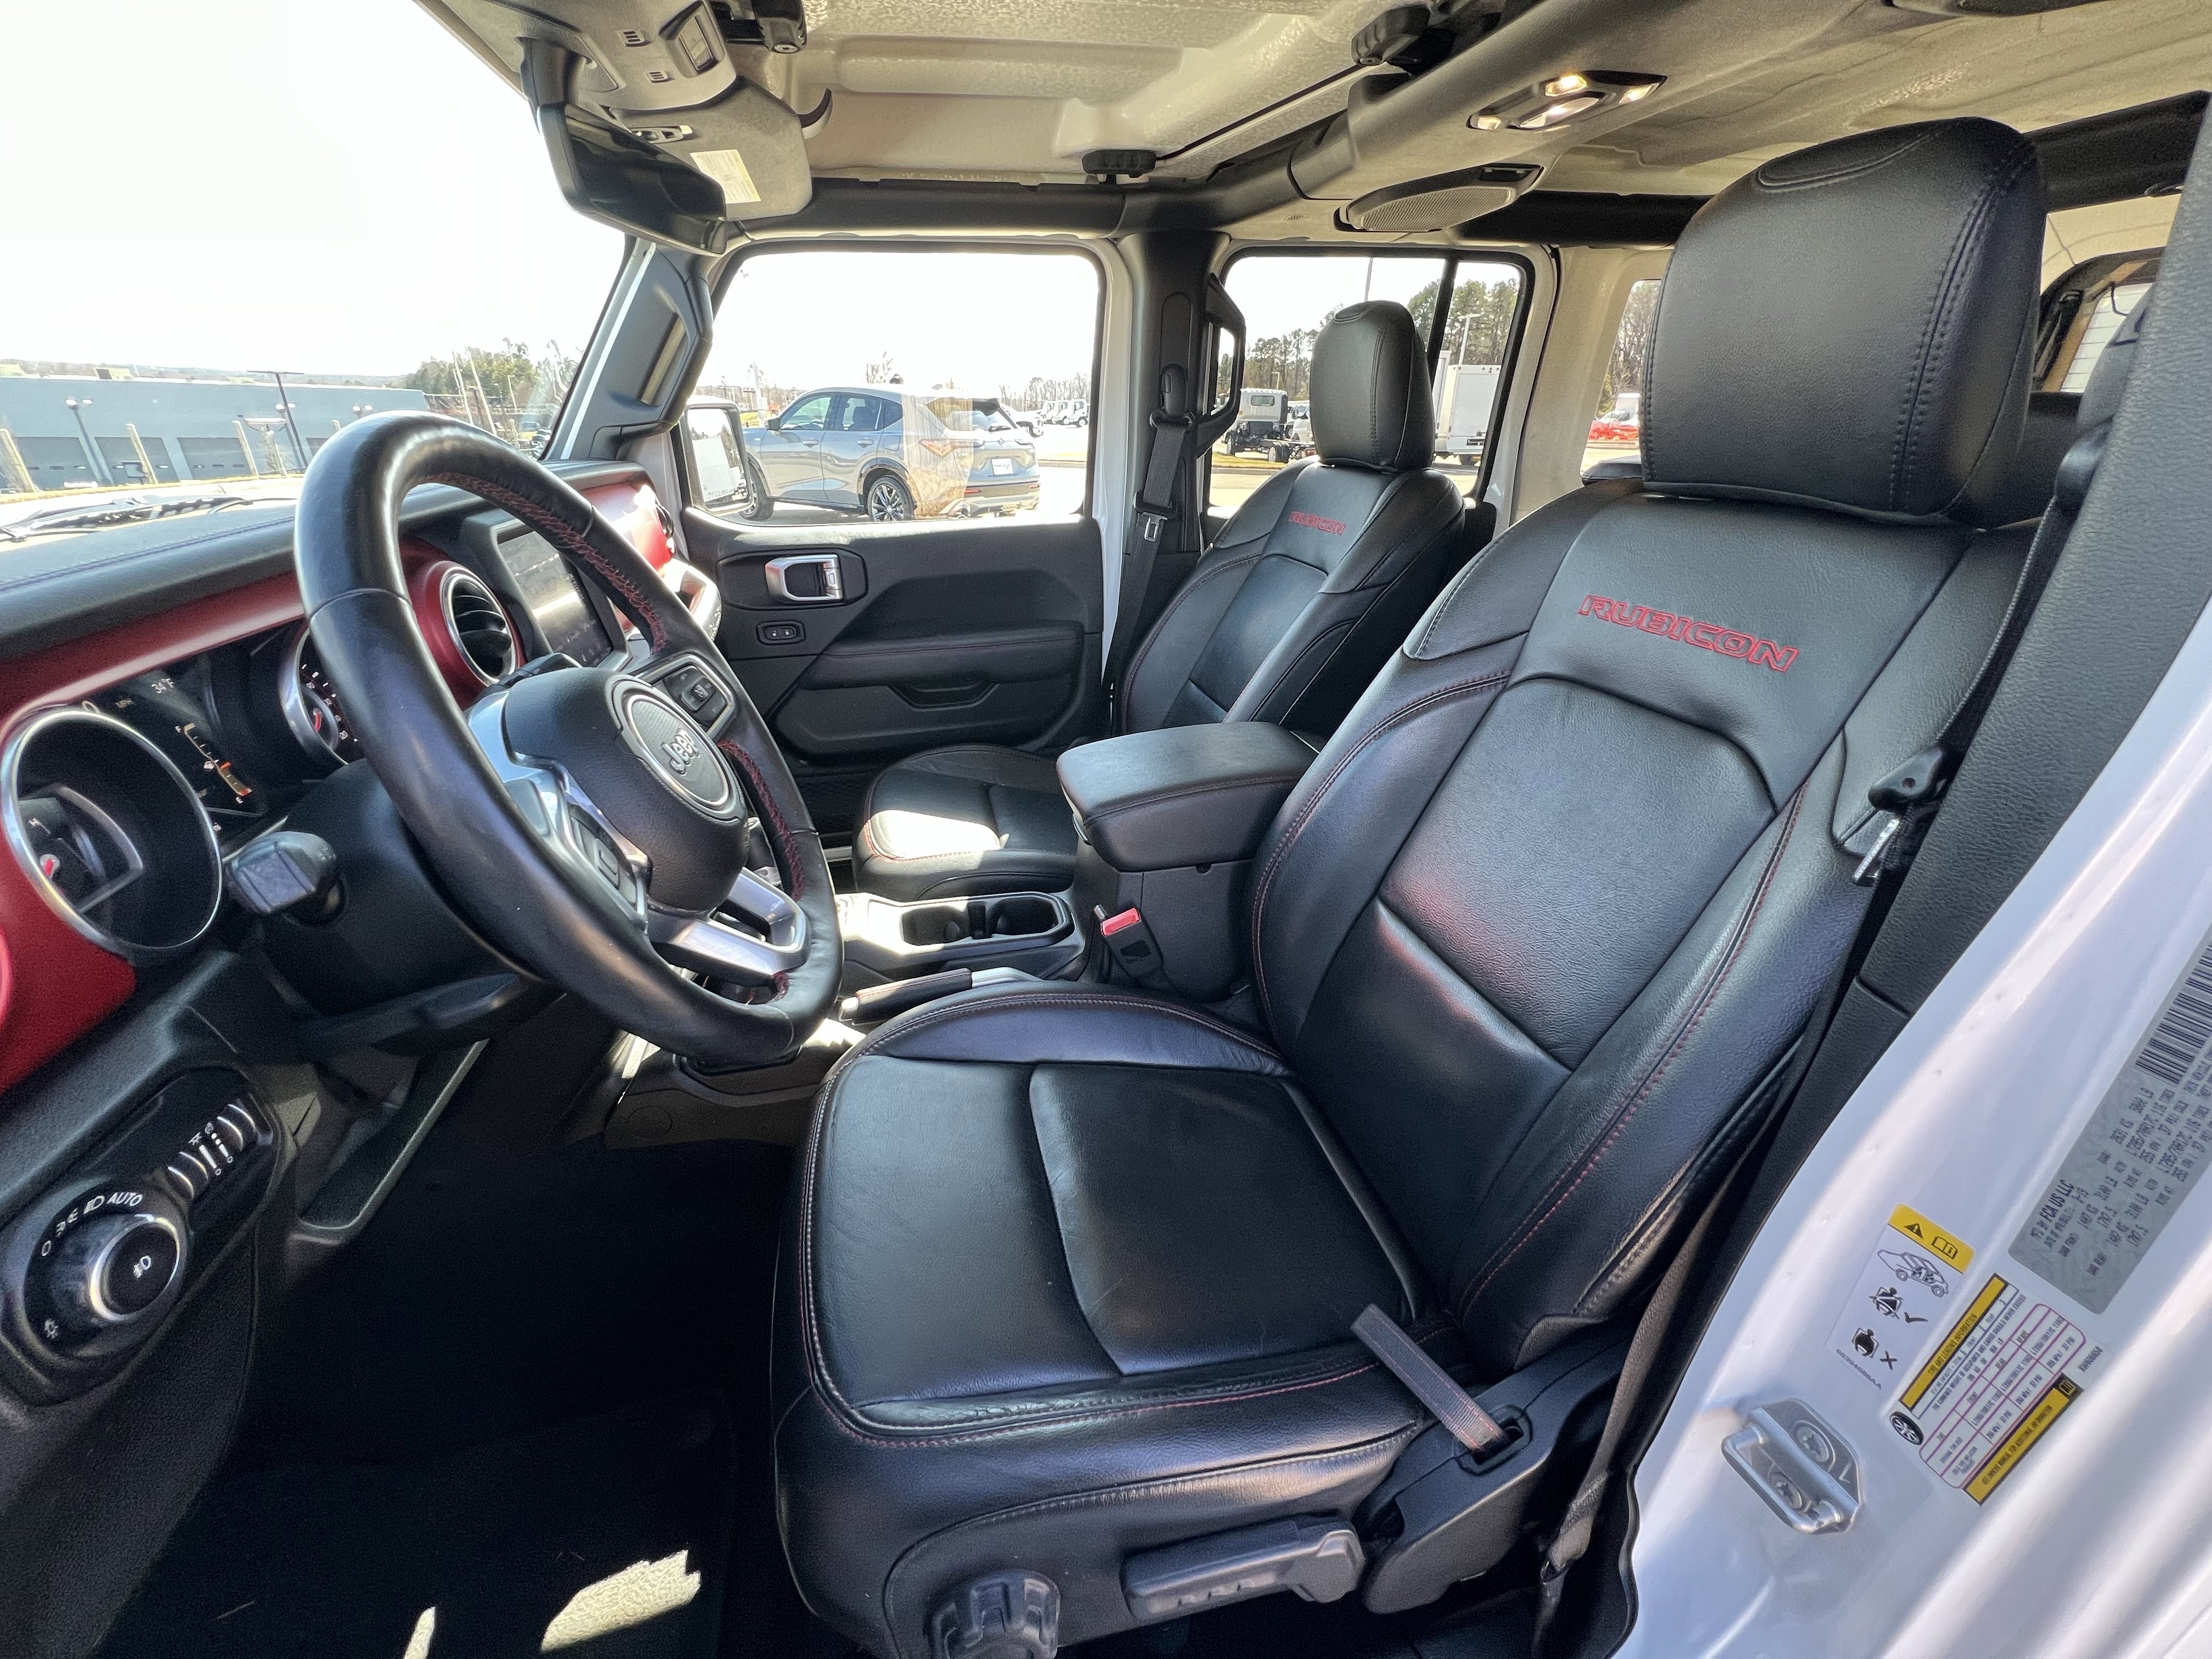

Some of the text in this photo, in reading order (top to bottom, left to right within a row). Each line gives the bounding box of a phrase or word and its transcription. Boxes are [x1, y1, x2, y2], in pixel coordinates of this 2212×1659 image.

[1288, 510, 1347, 536] RUBICON
[1577, 594, 1799, 673] RUBICON
[661, 729, 699, 774] Jeep
[2055, 1179, 2074, 1197] LLC
[2104, 1175, 2118, 1187] LB
[106, 1191, 143, 1207] AUTO
[2048, 1193, 2065, 1207] US
[2134, 1193, 2149, 1205] LB
[2039, 1204, 2058, 1222] FCA
